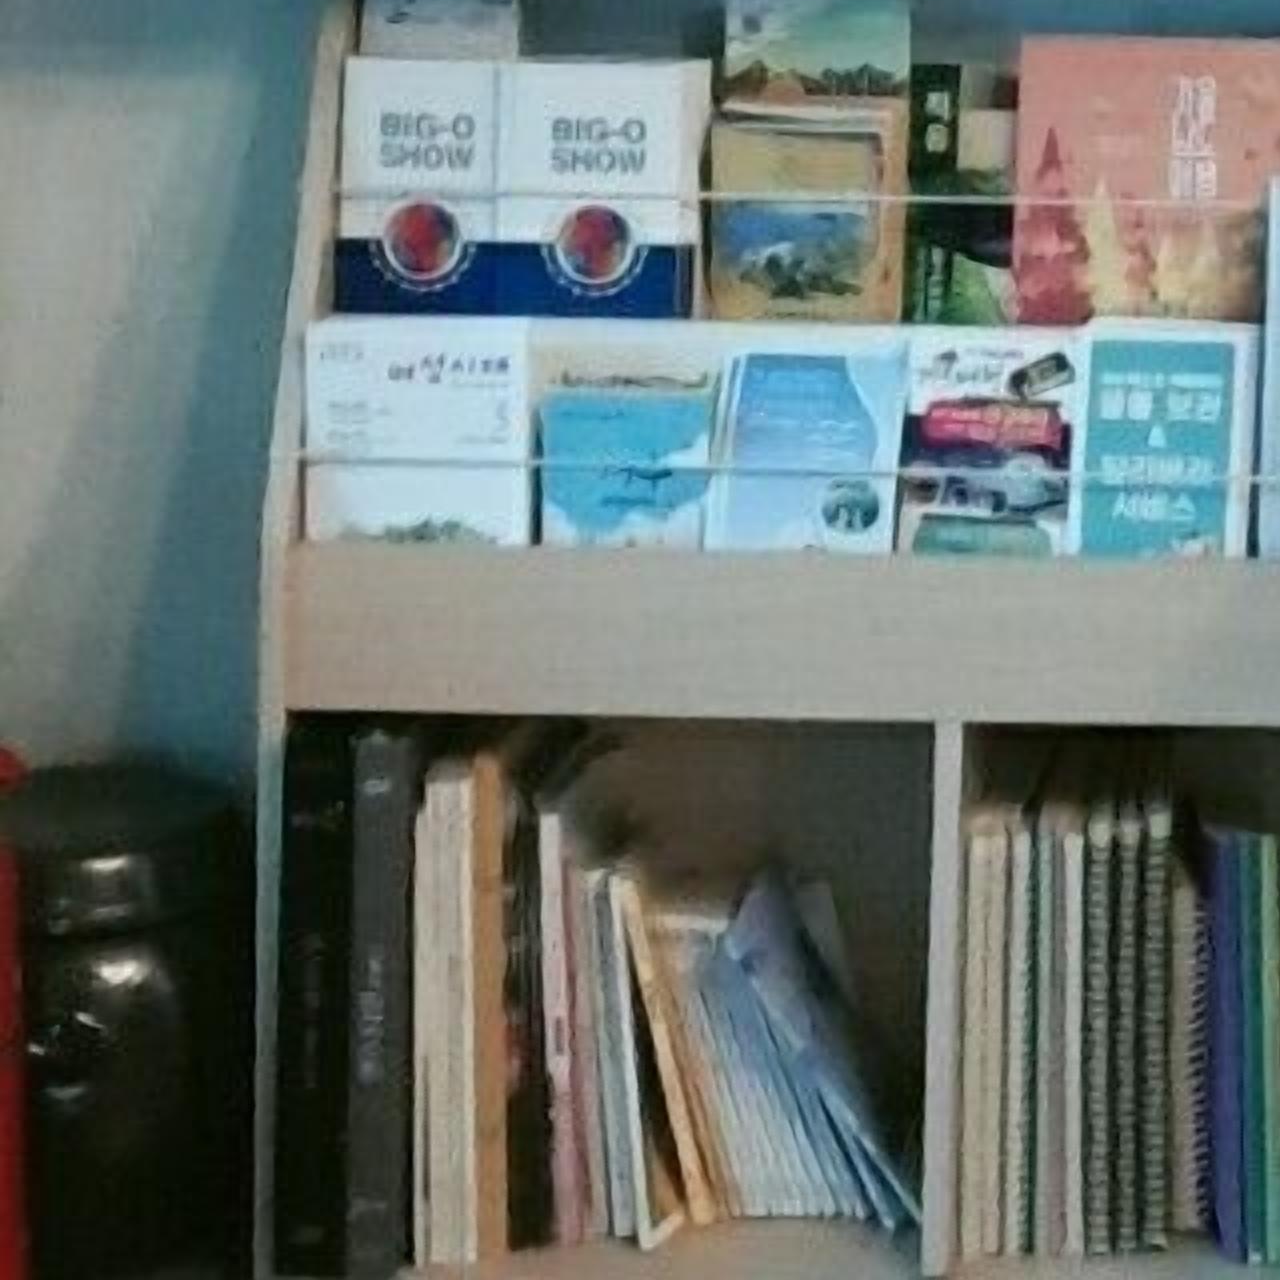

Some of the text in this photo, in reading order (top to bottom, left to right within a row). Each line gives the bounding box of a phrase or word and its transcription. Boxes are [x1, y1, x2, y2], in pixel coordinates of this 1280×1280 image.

[379, 110, 476, 141] BIG-O
[550, 117, 647, 145] BIG-O
[378, 142, 477, 171] SHOW
[550, 146, 647, 175] SHOW
